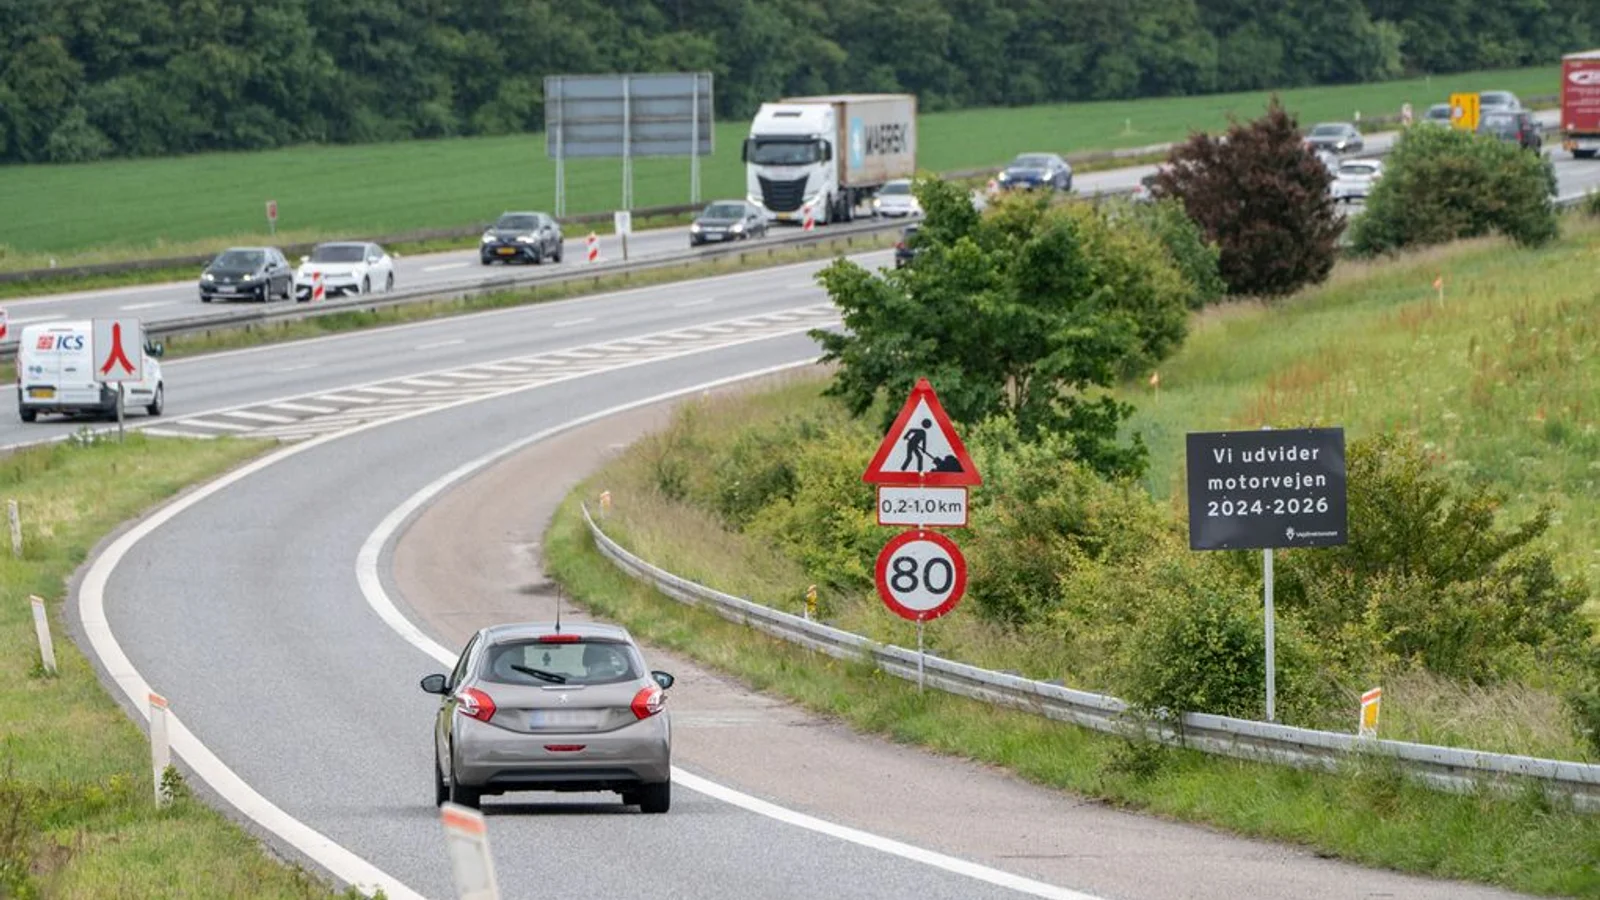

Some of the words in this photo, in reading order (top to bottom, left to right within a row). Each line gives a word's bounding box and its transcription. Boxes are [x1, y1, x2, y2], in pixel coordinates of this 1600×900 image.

[56, 335, 84, 350] ICS
[1213, 447, 1233, 463] Vi
[1242, 446, 1320, 463] udvider
[1207, 472, 1327, 490] motorvejen
[881, 499, 936, 514] 0,2-1,0
[939, 499, 962, 513] km
[1207, 497, 1329, 517] 2024-2026
[890, 556, 953, 595] 80
